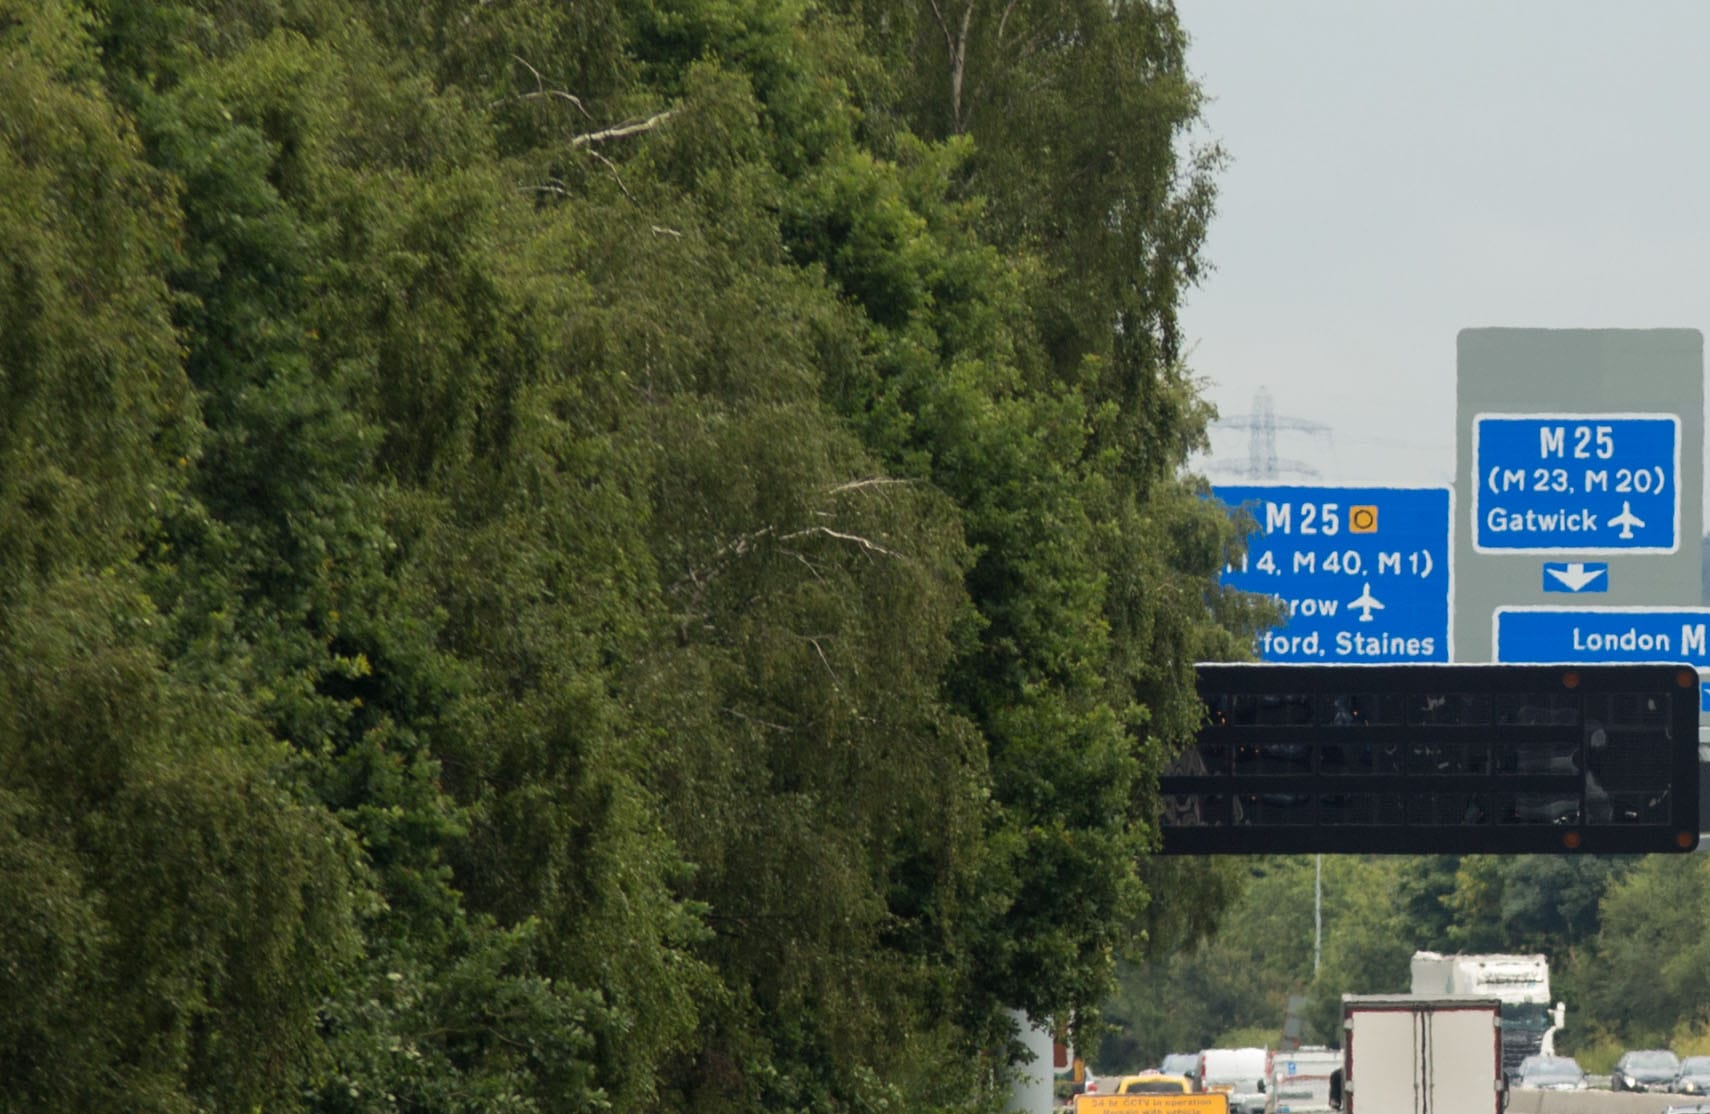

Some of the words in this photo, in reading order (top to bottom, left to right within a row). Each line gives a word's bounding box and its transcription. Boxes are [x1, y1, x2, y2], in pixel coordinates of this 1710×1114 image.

[1487, 507, 1597, 532] Gatwick
[1335, 631, 1435, 656] Staines
[1573, 627, 1670, 651] London
